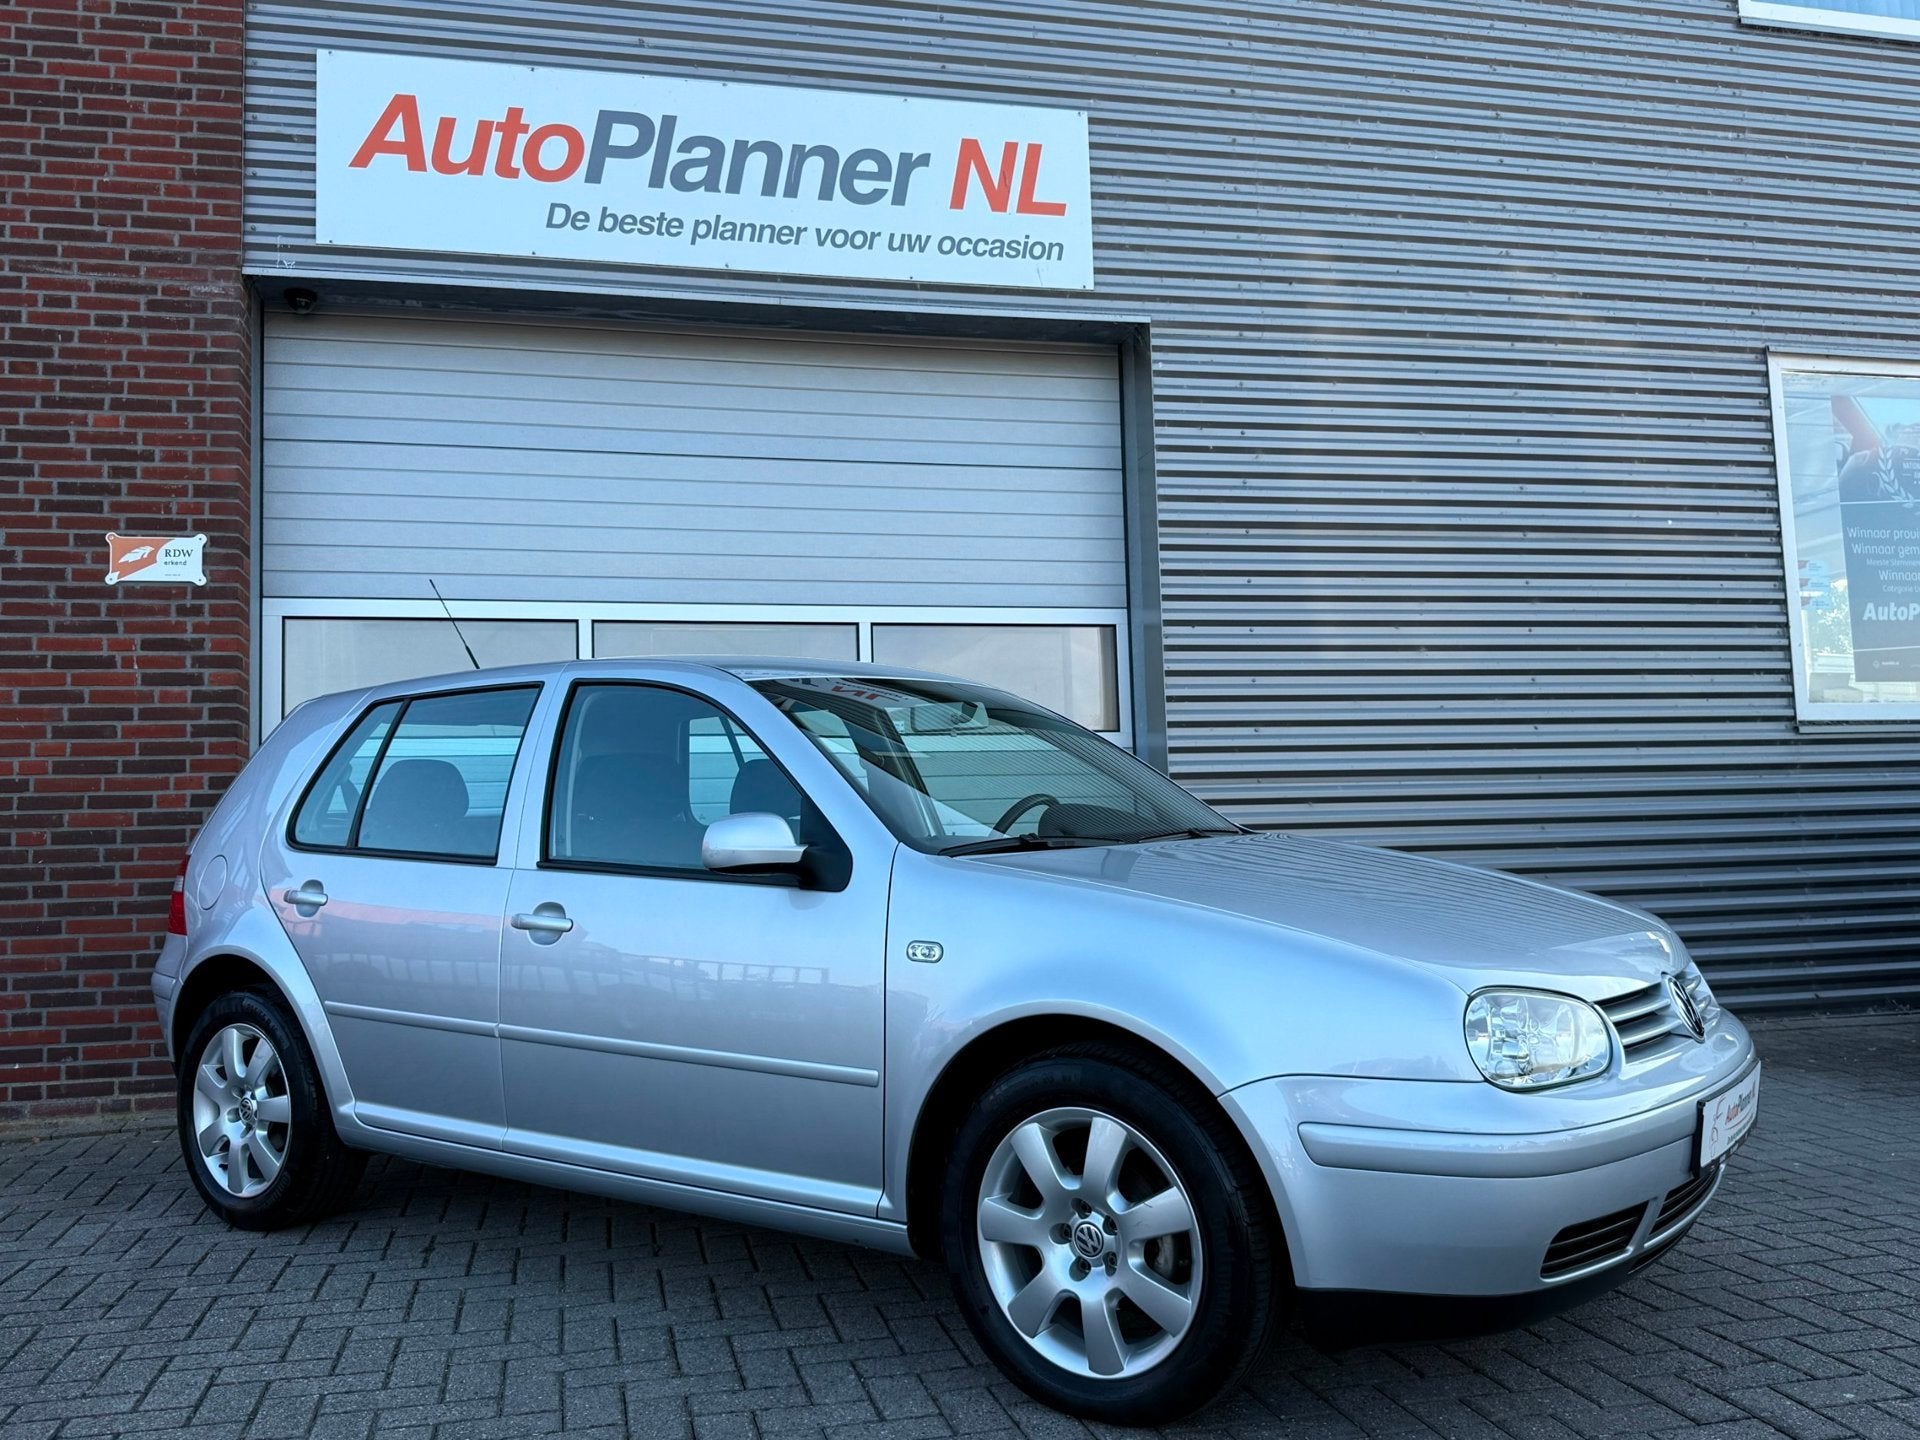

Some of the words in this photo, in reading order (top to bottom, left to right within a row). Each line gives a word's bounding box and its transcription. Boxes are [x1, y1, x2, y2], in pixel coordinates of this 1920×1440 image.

[348, 94, 931, 207] AutoPlanner
[949, 138, 1067, 216] NL
[546, 203, 590, 231] De
[598, 207, 684, 238] beste
[690, 214, 808, 246] planner
[816, 228, 882, 251] voor
[888, 233, 931, 253] uw
[938, 234, 1064, 261] occasion
[1846, 527, 1891, 539] Winnaar
[164, 549, 193, 558] RDW
[1851, 543, 1896, 555] Winnaar
